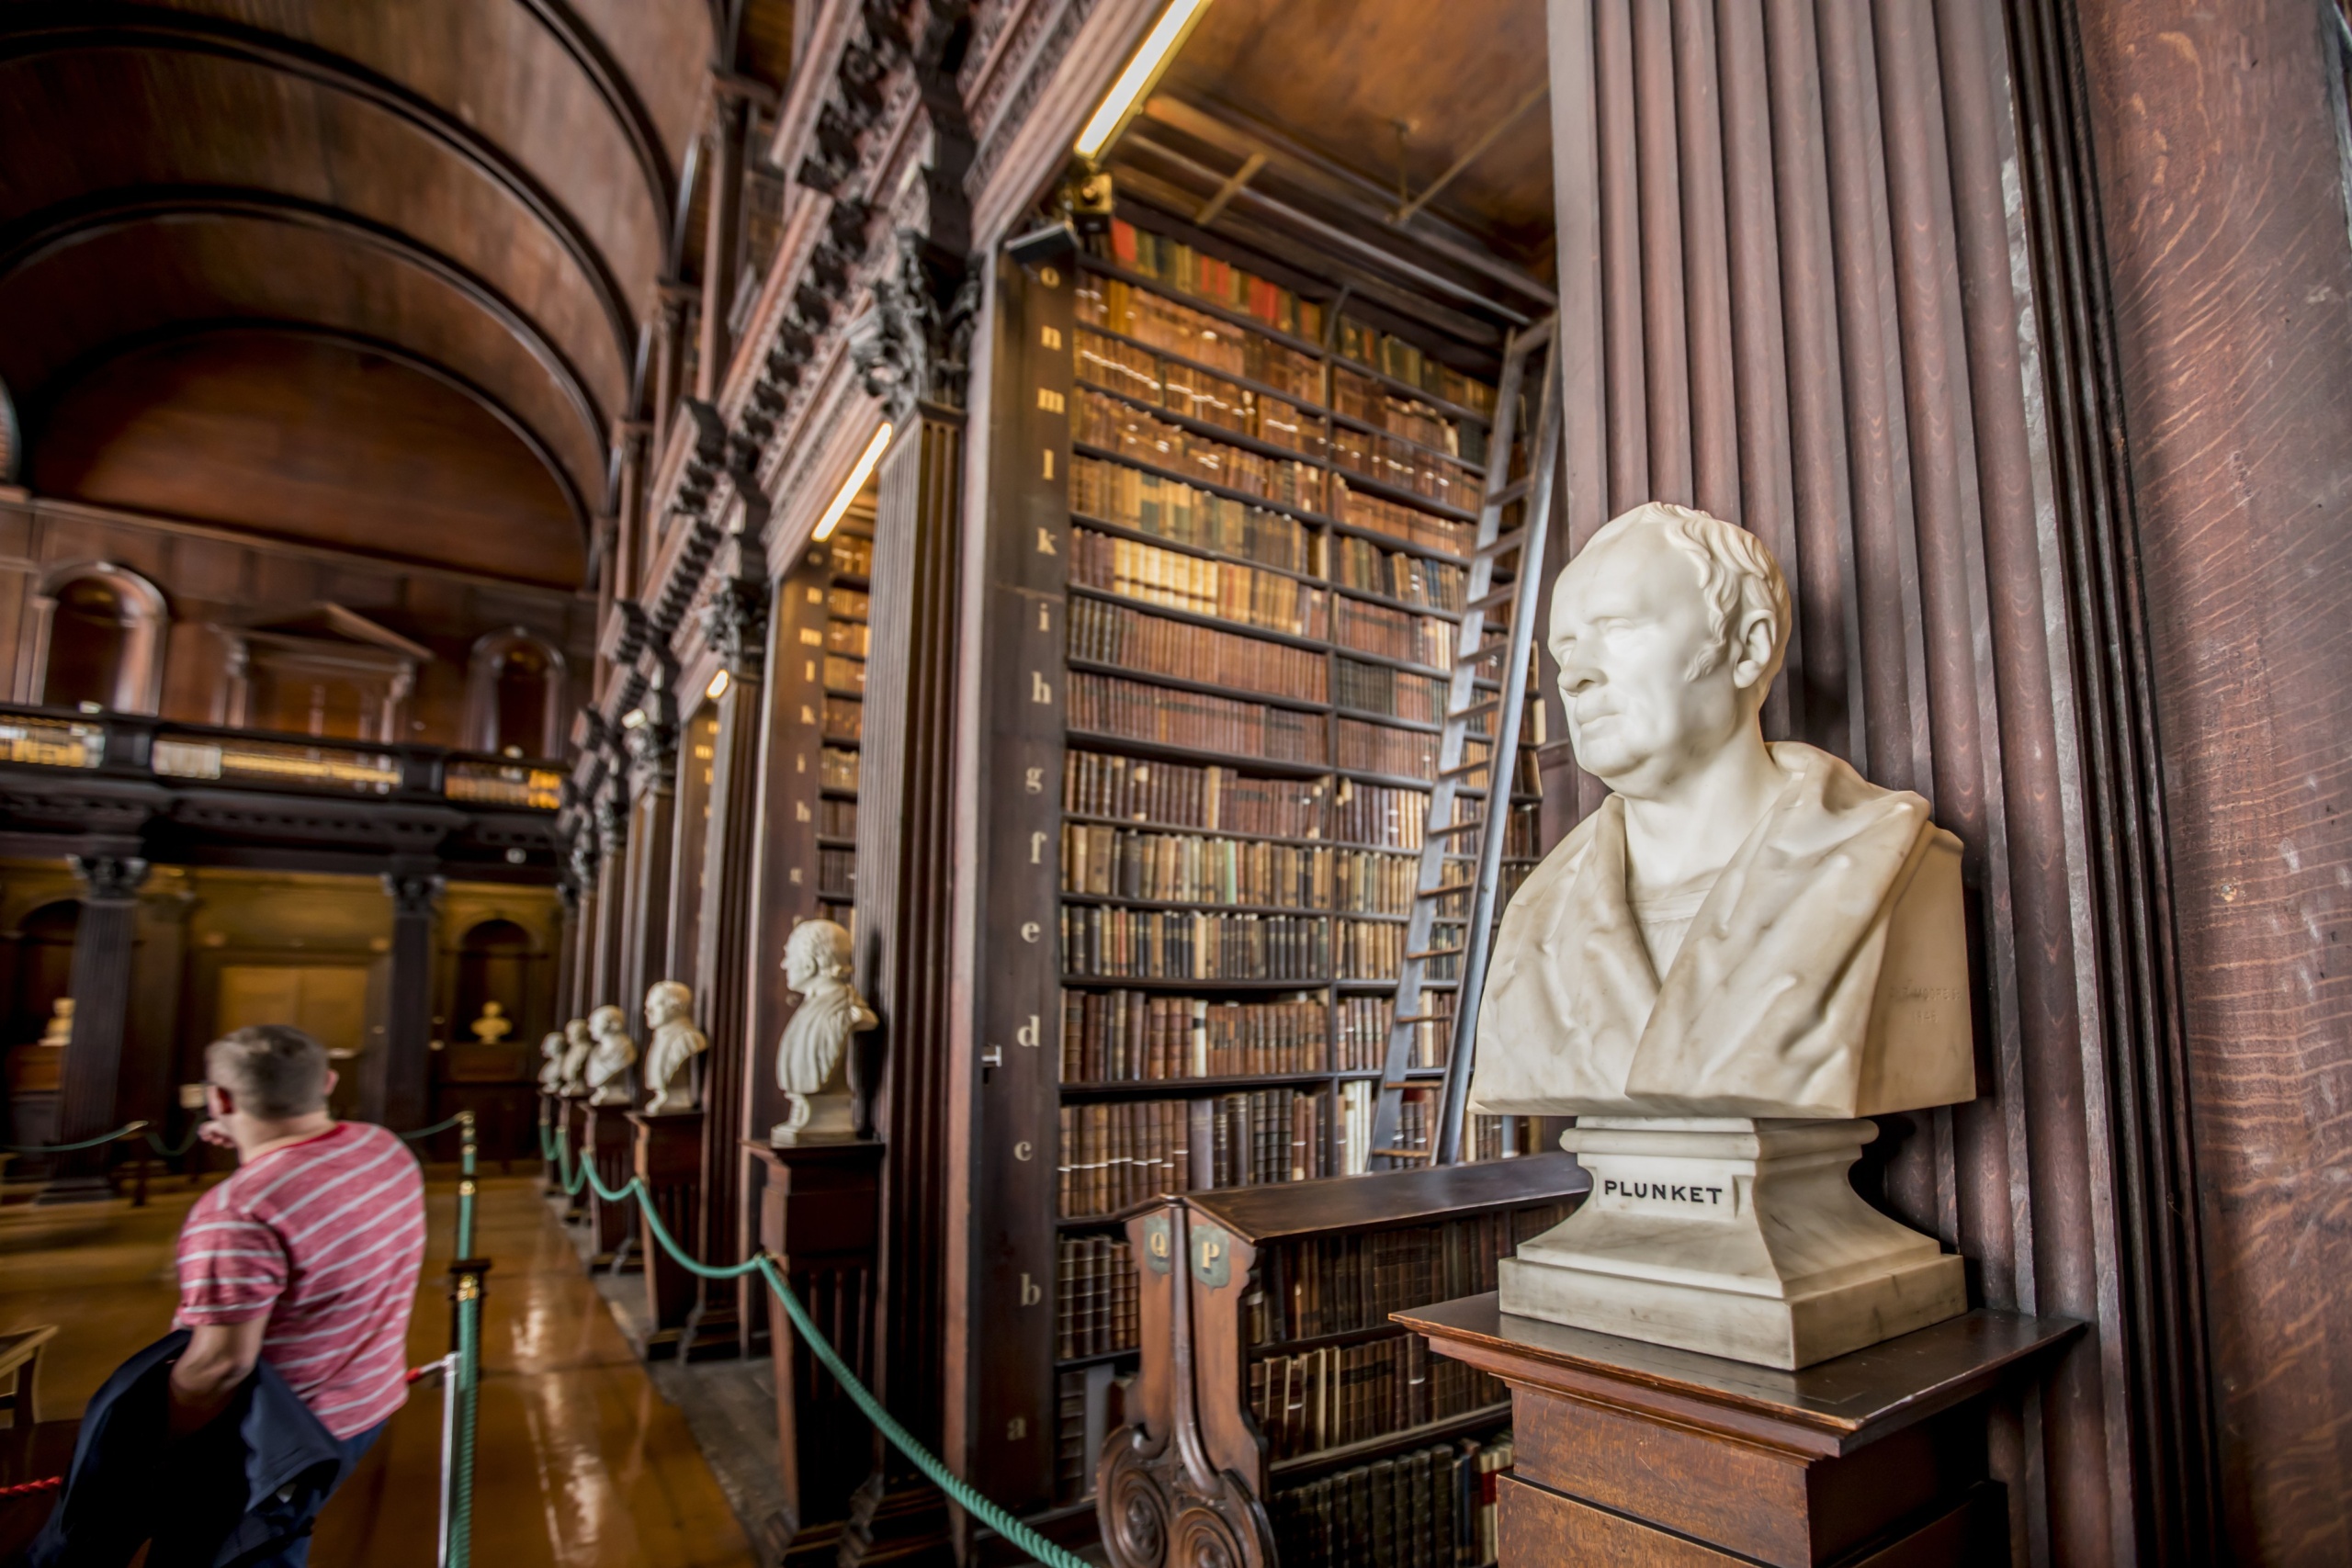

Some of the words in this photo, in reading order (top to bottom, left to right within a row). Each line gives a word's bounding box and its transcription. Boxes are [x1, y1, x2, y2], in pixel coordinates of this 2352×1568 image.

[1041, 325, 1062, 350] n
[1037, 388, 1065, 413] m
[1037, 527, 1057, 555] k
[1039, 603, 1049, 632] i
[1032, 671, 1052, 705] h
[1025, 767, 1044, 792] g
[1031, 831, 1047, 864] f
[1021, 922, 1041, 942] e
[1016, 1014, 1040, 1047] d
[1013, 1141, 1032, 1162] c
[1604, 1179, 1723, 1205] PLUNKET
[1150, 1232, 1170, 1258] Q
[1021, 1273, 1042, 1306] b
[1007, 1416, 1026, 1440] a
